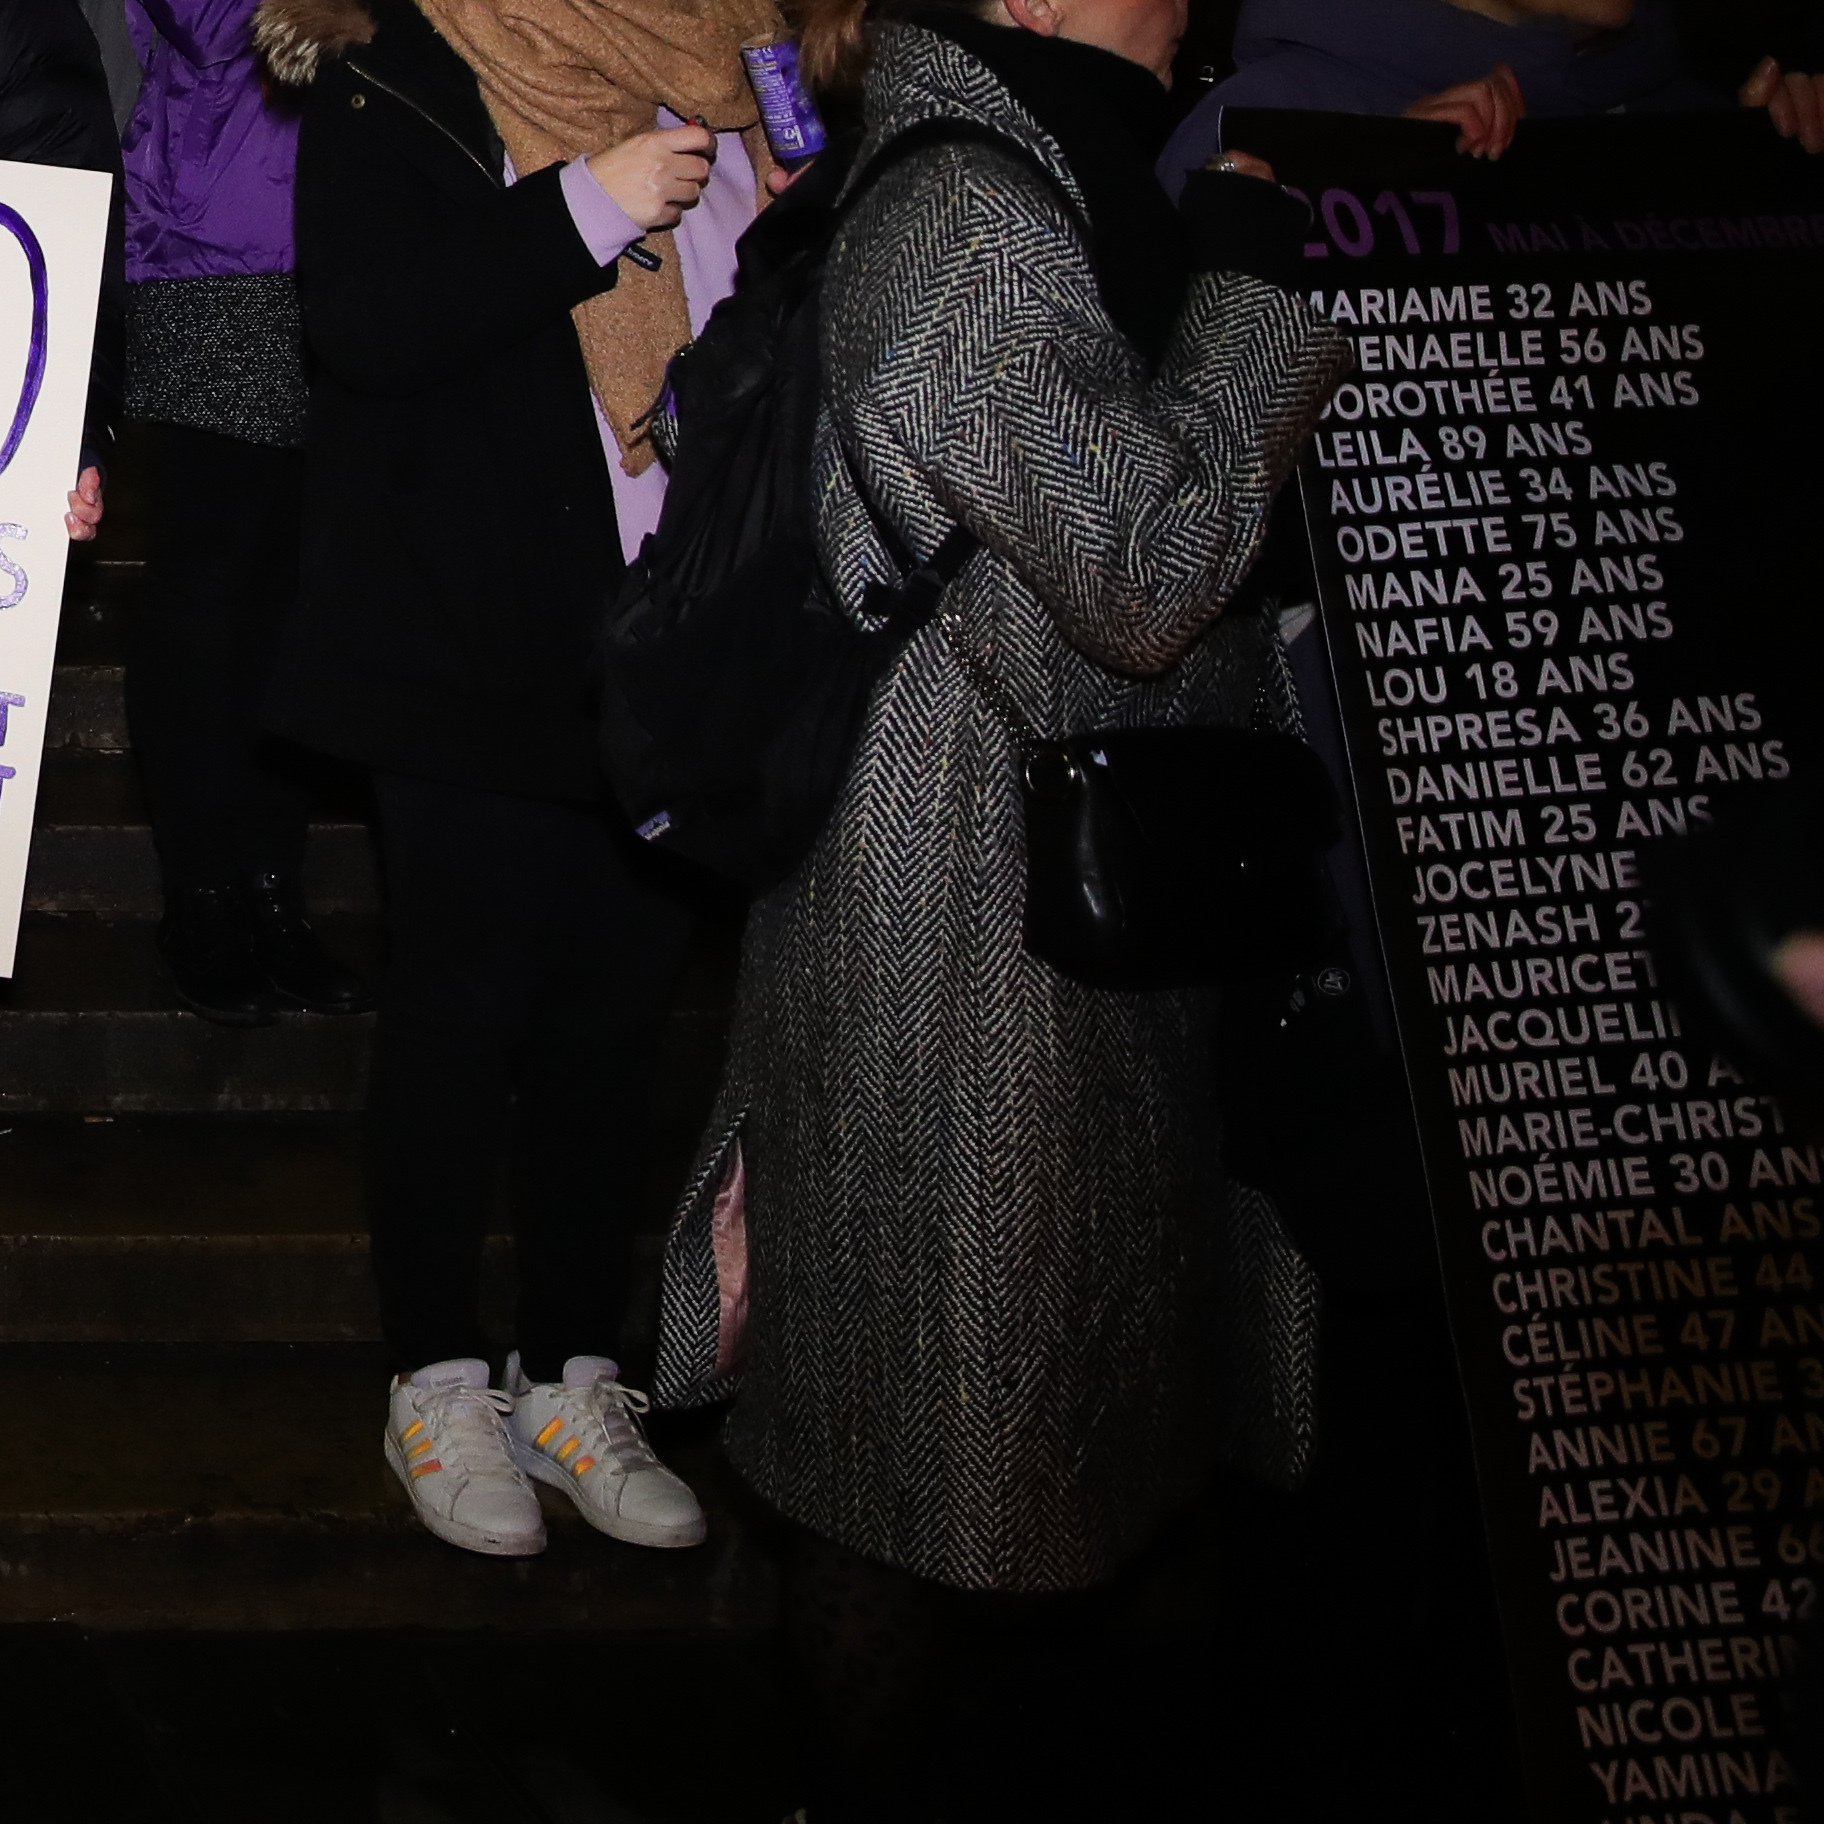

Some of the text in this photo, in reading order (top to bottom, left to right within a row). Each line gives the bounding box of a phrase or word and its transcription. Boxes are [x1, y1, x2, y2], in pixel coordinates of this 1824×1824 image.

[1285, 185, 1461, 259] 017
[1485, 220, 1571, 253] MAI
[1507, 283, 1554, 319] 32
[1569, 280, 1651, 316] ANS
[1350, 324, 1704, 372] ENAELLE 56 ANS
[1320, 369, 1699, 420] OROTHÉE 41 ANS
[1315, 421, 1592, 468] LEILA 89 ANS
[1332, 462, 1676, 514] AURÉLIE 34 ANS
[1337, 507, 1683, 562] ODETTE 75 ANS
[1345, 554, 1663, 610] MANA 25 ANS
[1355, 601, 1673, 658] NAFIA 59 ANS
[1366, 653, 1634, 706] LOU 18 ANS
[1379, 693, 1761, 755] SHPRESA 36 ANS
[1387, 740, 1789, 804] DANIELLE 62 ANS
[1397, 795, 1708, 854] FATIM 25 ANS
[1413, 851, 1641, 904] JOCELYNE
[1417, 901, 1651, 953] ZENASH 2
[1448, 1056, 1616, 1106] MURIEL
[1631, 1051, 1688, 1090] 40
[1469, 1143, 1824, 1209] NOÉMIE 30 AN
[1482, 1198, 1820, 1261] CHANTAL ANS
[1493, 1252, 1813, 1313] CHRISTINE 44
[1502, 1312, 1666, 1367] CÉLINE
[1680, 1310, 1735, 1350] 47
[1513, 1362, 1785, 1421] STÉPHANIE
[1529, 1424, 1673, 1474] ANNIE
[1692, 1417, 1746, 1459] 67
[1540, 1473, 1707, 1528] ALEXIA
[1722, 1469, 1781, 1512] 29
[1550, 1526, 1760, 1582] JEANINE
[1556, 1582, 1744, 1636] CORINE
[1577, 1694, 1764, 1748] NICOLE
[1590, 1749, 1798, 1803] YAMINA
